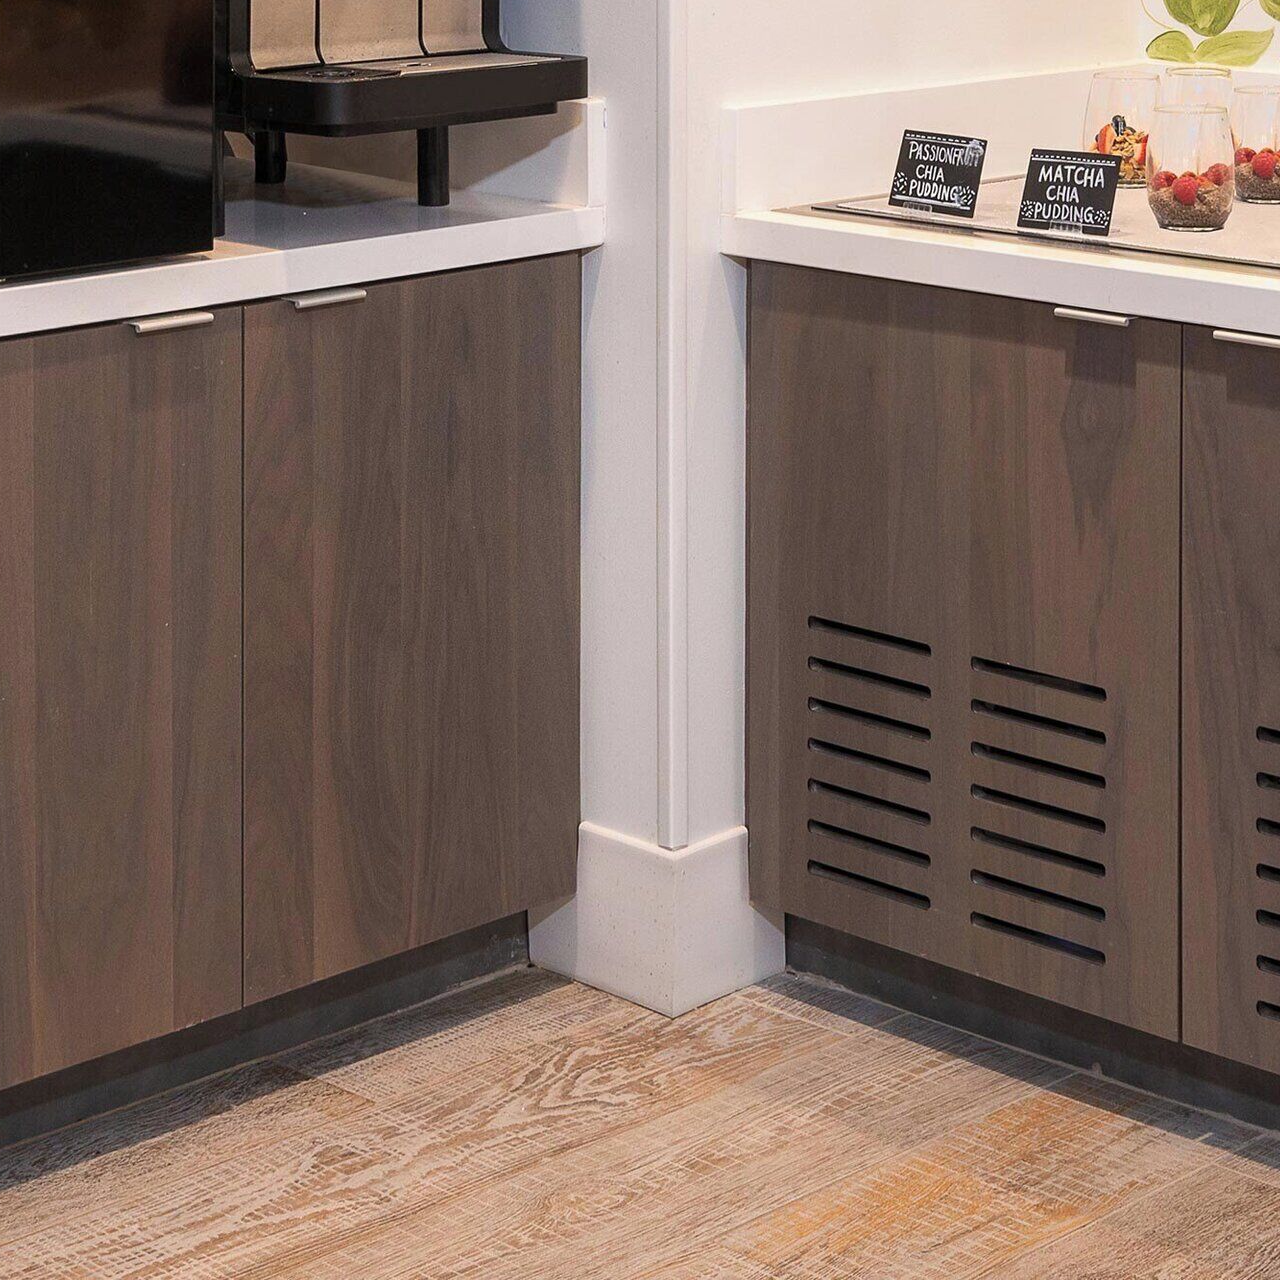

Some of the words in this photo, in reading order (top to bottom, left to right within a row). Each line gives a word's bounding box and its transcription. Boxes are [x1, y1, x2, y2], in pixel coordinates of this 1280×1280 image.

[915, 164, 945, 183] CHIA
[1038, 164, 1105, 189] MATCHA
[908, 179, 961, 202] PUDDING
[1045, 185, 1080, 204] CHIA
[1033, 202, 1095, 225] PUDDING
